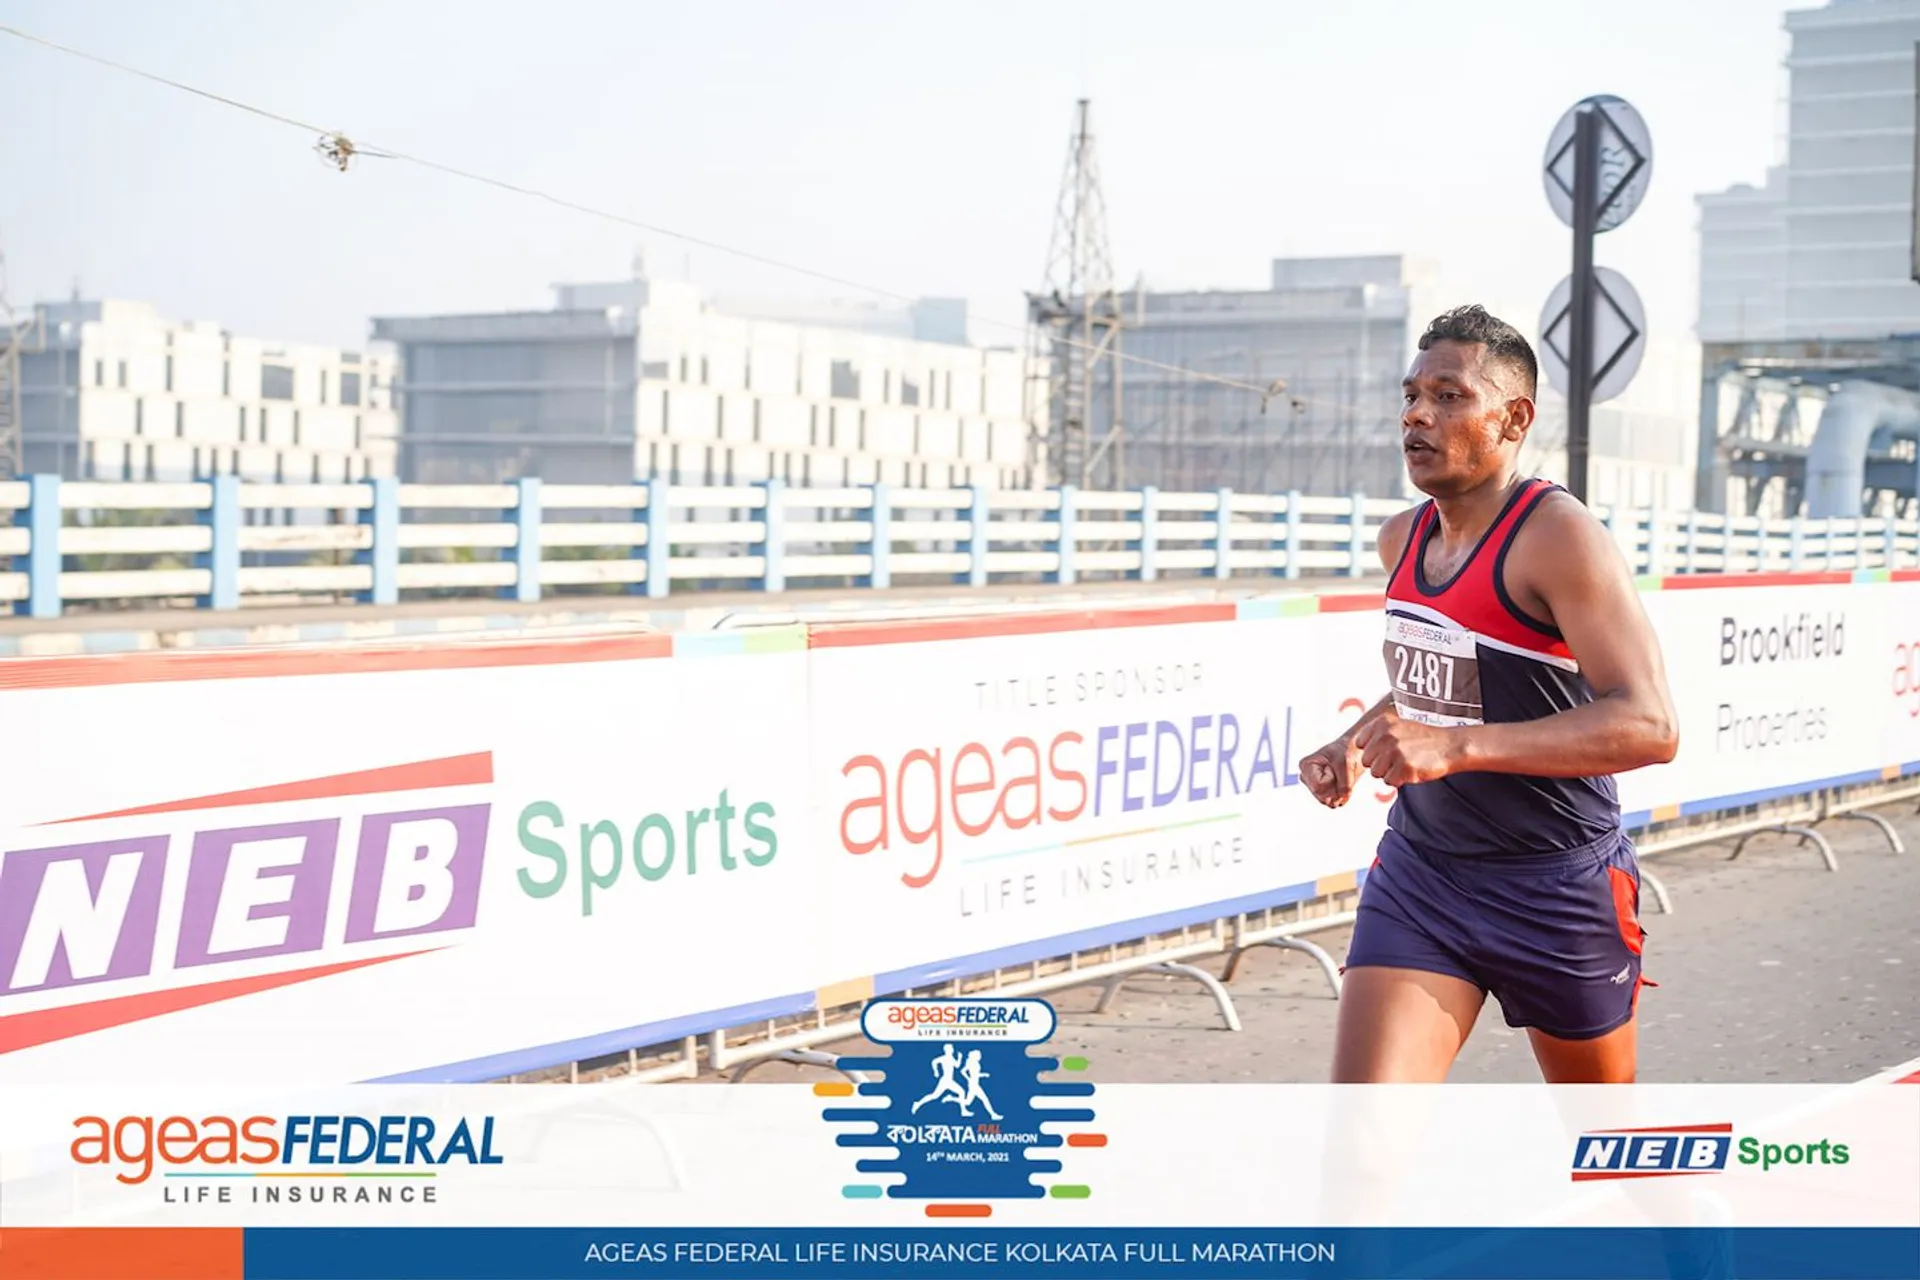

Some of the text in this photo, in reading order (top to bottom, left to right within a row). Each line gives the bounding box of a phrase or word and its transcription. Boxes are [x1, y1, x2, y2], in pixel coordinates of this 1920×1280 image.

[1720, 612, 1845, 666] Brookfield
[974, 661, 1204, 710] TITLE SPONSOR
[1394, 645, 1454, 701] 2487
[8, 787, 778, 990] NEB Sports
[959, 836, 1246, 917] LIFE INSURANCE
